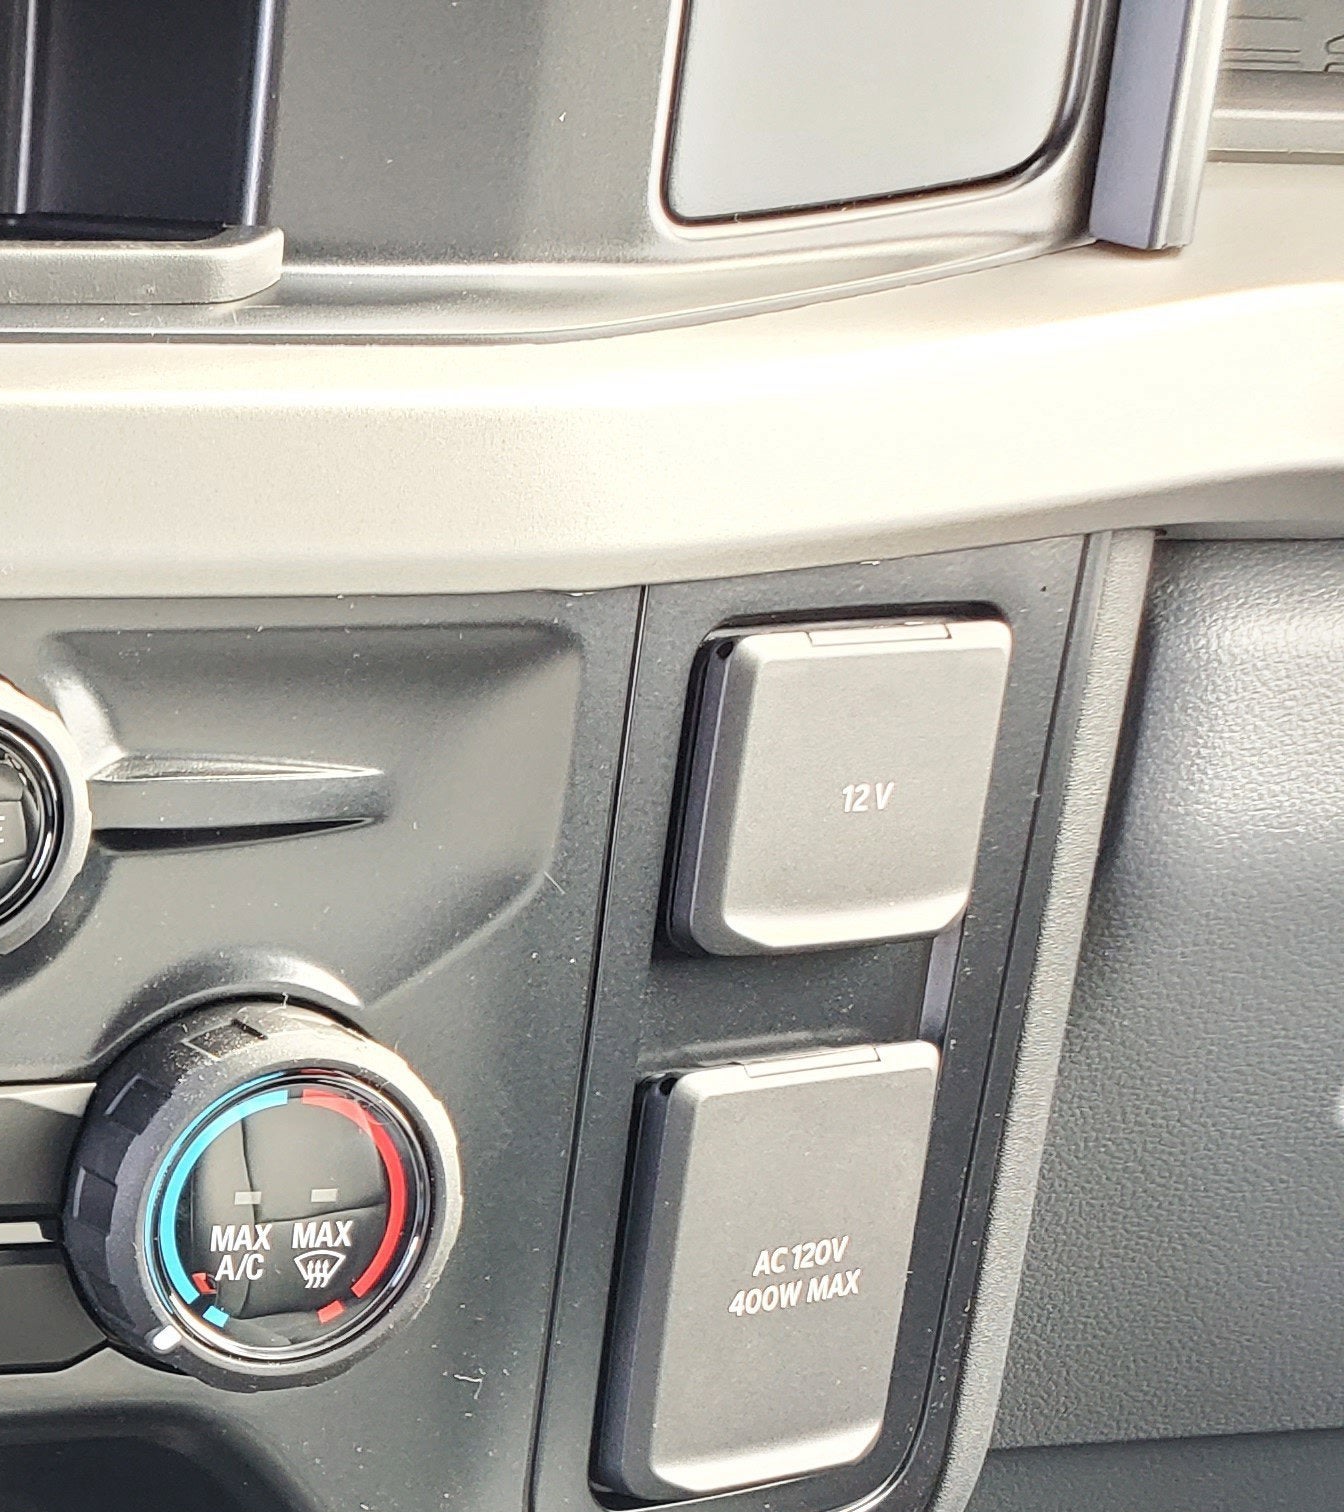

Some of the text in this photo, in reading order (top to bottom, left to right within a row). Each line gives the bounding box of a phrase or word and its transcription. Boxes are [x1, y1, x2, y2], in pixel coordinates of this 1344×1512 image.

[210, 1223, 273, 1252] MAX
[292, 1220, 353, 1249] MAX
[214, 1253, 265, 1281] A/C
[752, 1235, 849, 1277] AC 120V
[728, 1268, 861, 1317] 400W MAX
